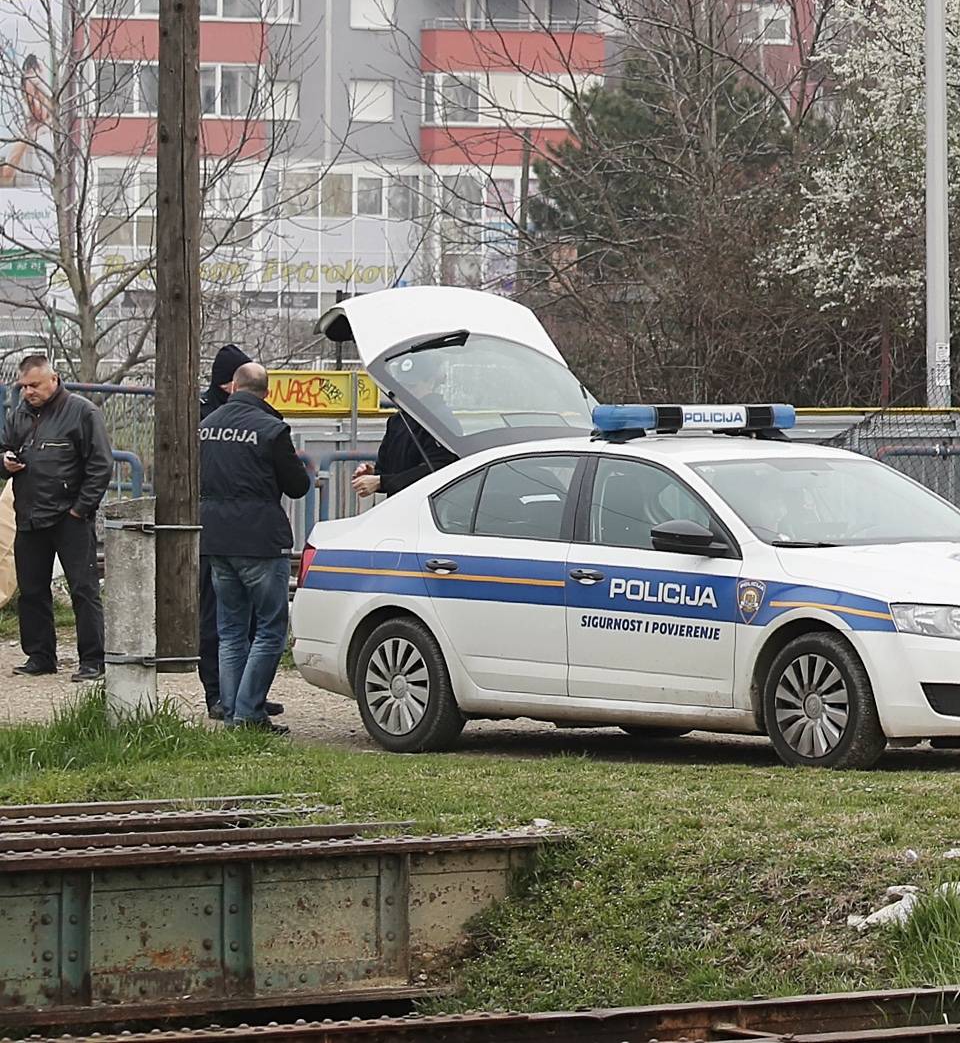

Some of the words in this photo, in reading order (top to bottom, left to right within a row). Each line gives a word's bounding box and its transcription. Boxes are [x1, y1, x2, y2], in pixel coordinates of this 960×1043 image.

[684, 412, 743, 423] POLICIJA
[198, 427, 258, 445] OLICIJA
[609, 578, 718, 609] POLICIJA
[581, 615, 643, 633] SIGURNOST
[645, 622, 649, 634] I
[651, 622, 721, 641] POVJERENJE
